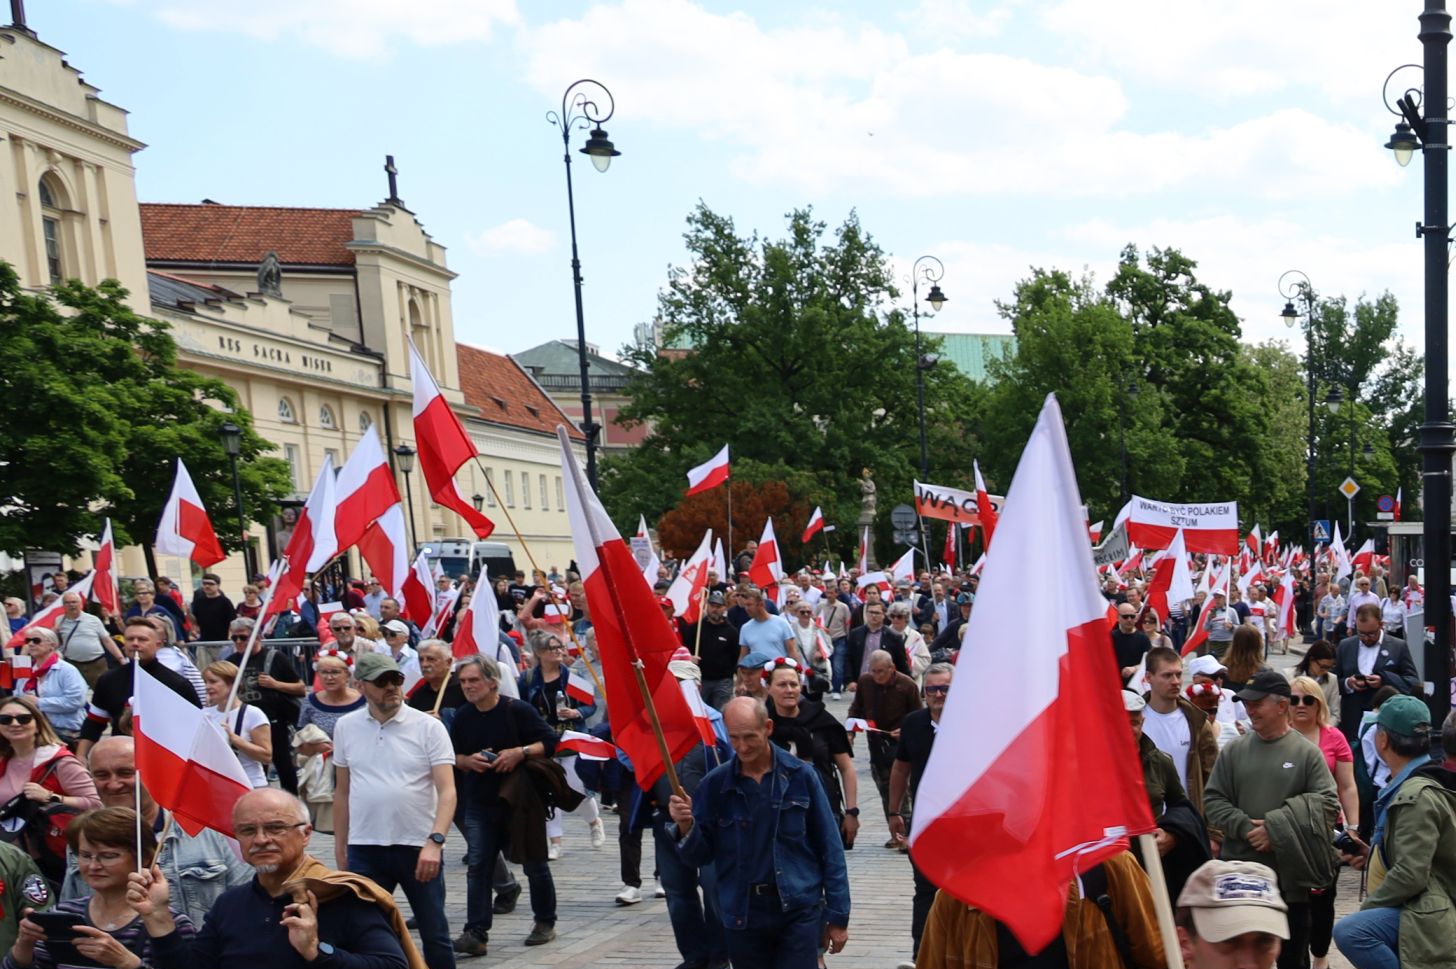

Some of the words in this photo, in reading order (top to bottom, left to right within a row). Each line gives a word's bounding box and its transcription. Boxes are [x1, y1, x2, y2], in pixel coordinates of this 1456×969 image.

[218, 336, 241, 351] RES
[253, 344, 290, 363] SACRA
[1187, 505, 1229, 516] POLAKIEM
[1171, 515, 1198, 527] SZTUM
